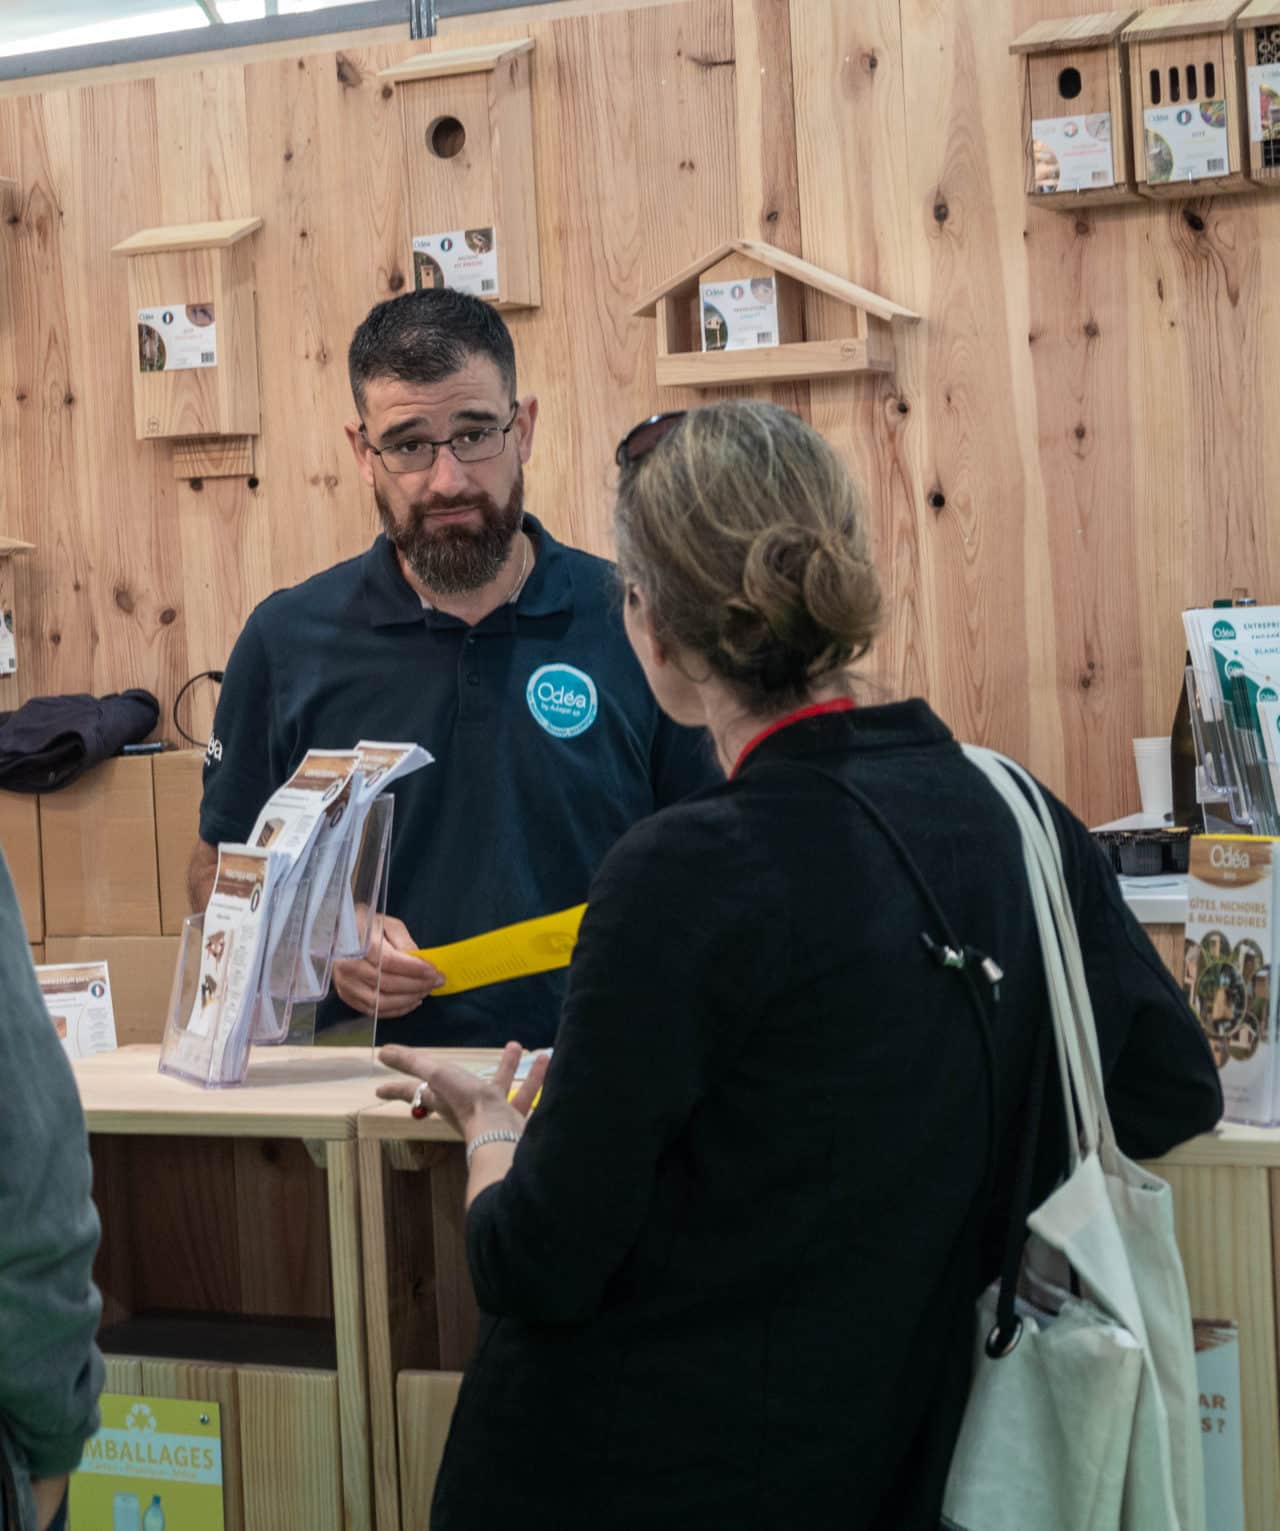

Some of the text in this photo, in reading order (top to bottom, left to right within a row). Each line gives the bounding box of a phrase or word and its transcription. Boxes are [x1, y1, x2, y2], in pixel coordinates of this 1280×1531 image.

[538, 682, 587, 709] Odéa
[207, 731, 223, 761] éa
[1209, 844, 1250, 868] Odéa
[1199, 1393, 1226, 1409] AR
[84, 1439, 214, 1471] MBALLAGES
